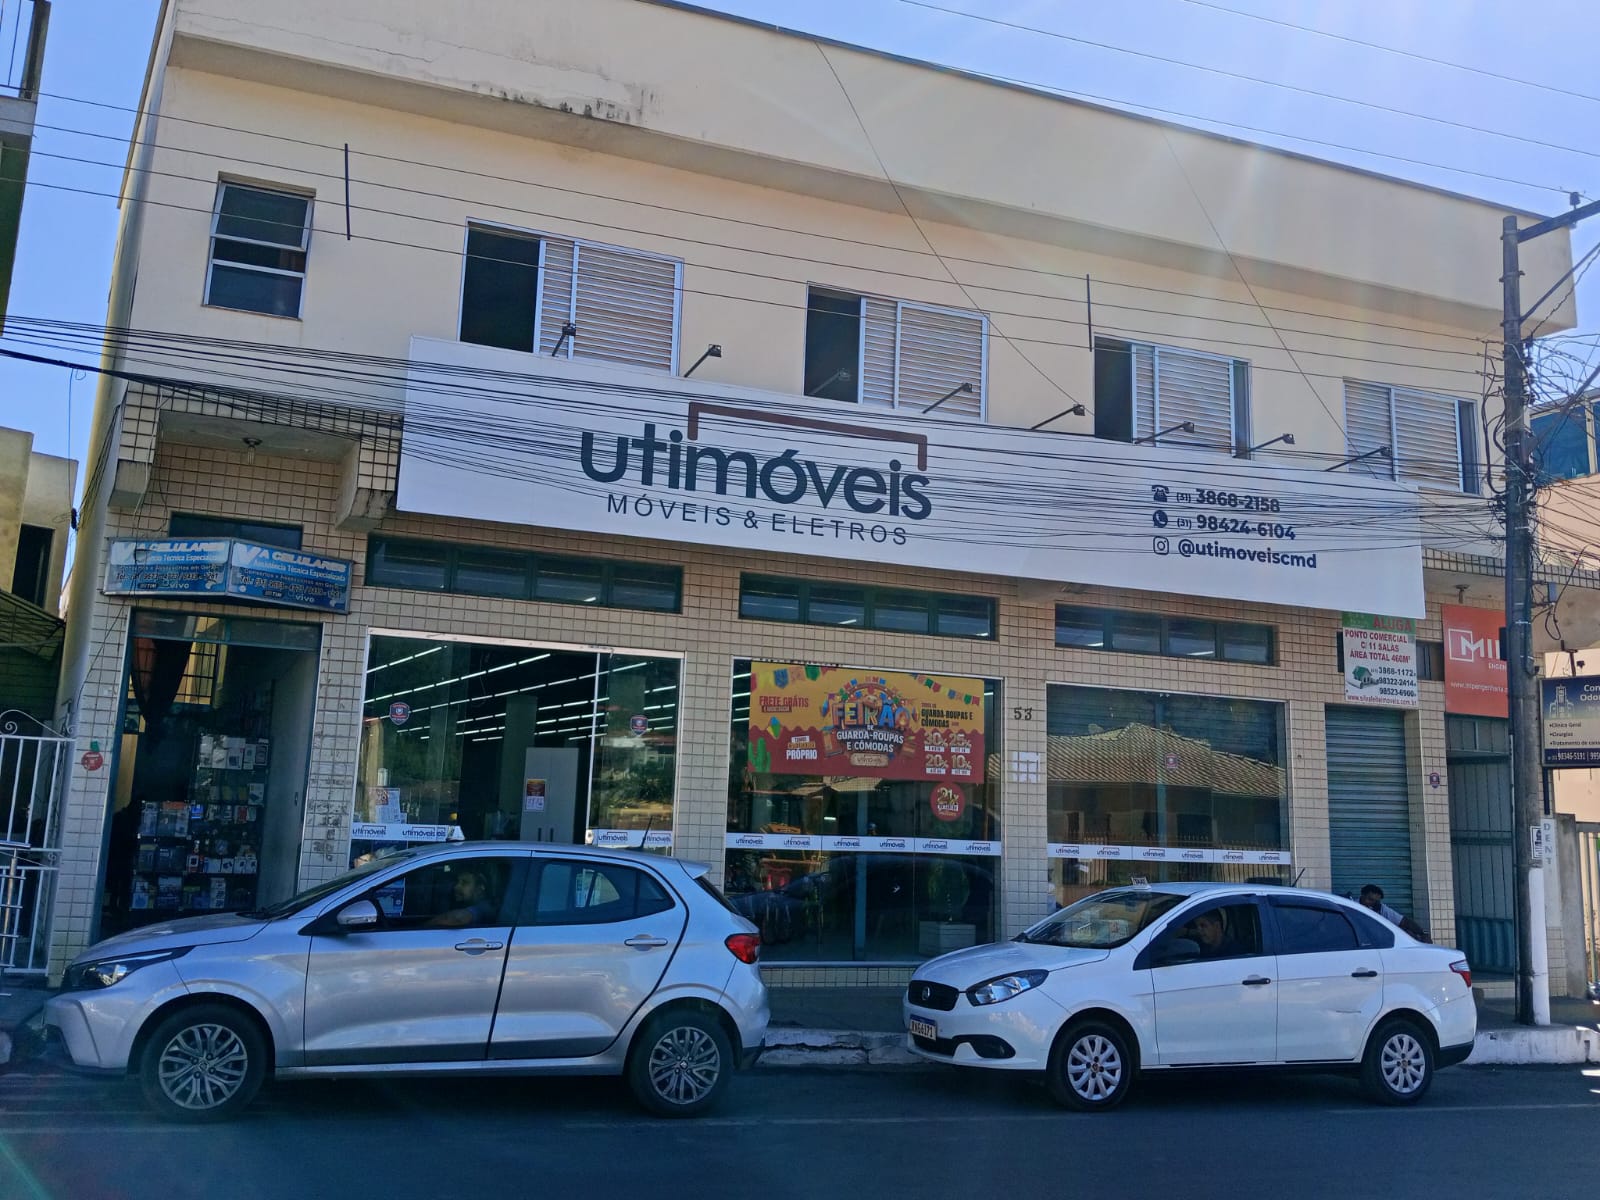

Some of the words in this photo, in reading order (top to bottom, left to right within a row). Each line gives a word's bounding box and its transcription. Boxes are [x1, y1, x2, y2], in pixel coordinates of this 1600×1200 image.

[580, 423, 932, 520] utimóveis
[1176, 491, 1192, 503] (31)
[1196, 488, 1281, 513] 3868-2158
[607, 493, 731, 526] MÓVEIS
[743, 510, 759, 529] &
[772, 513, 907, 545] ELETROS
[1177, 517, 1192, 530] (31)
[1196, 514, 1296, 540] 98424-6104
[1178, 538, 1317, 569] @utimoveiscmd
[272, 551, 346, 573] CELULARES
[295, 593, 315, 603] vivo
[1373, 614, 1412, 633] ALUGA
[1344, 629, 1368, 639] PONTO
[1369, 632, 1408, 644] COMERCIAL
[1369, 642, 1376, 650] 11
[1378, 643, 1399, 653] SALAS
[1369, 652, 1390, 662] TOTAL
[759, 695, 782, 707] FRETE
[783, 694, 809, 708] GRÁTIS
[921, 708, 968, 720] GUARDA-ROUPAS
[1013, 706, 1033, 721] 53
[921, 717, 949, 728] CÔMODAS
[836, 730, 904, 744] GUARDA-ROUPAS
[846, 742, 852, 751] E
[854, 740, 894, 753] CÔMODAS
[786, 748, 818, 760] PRÓPRIO
